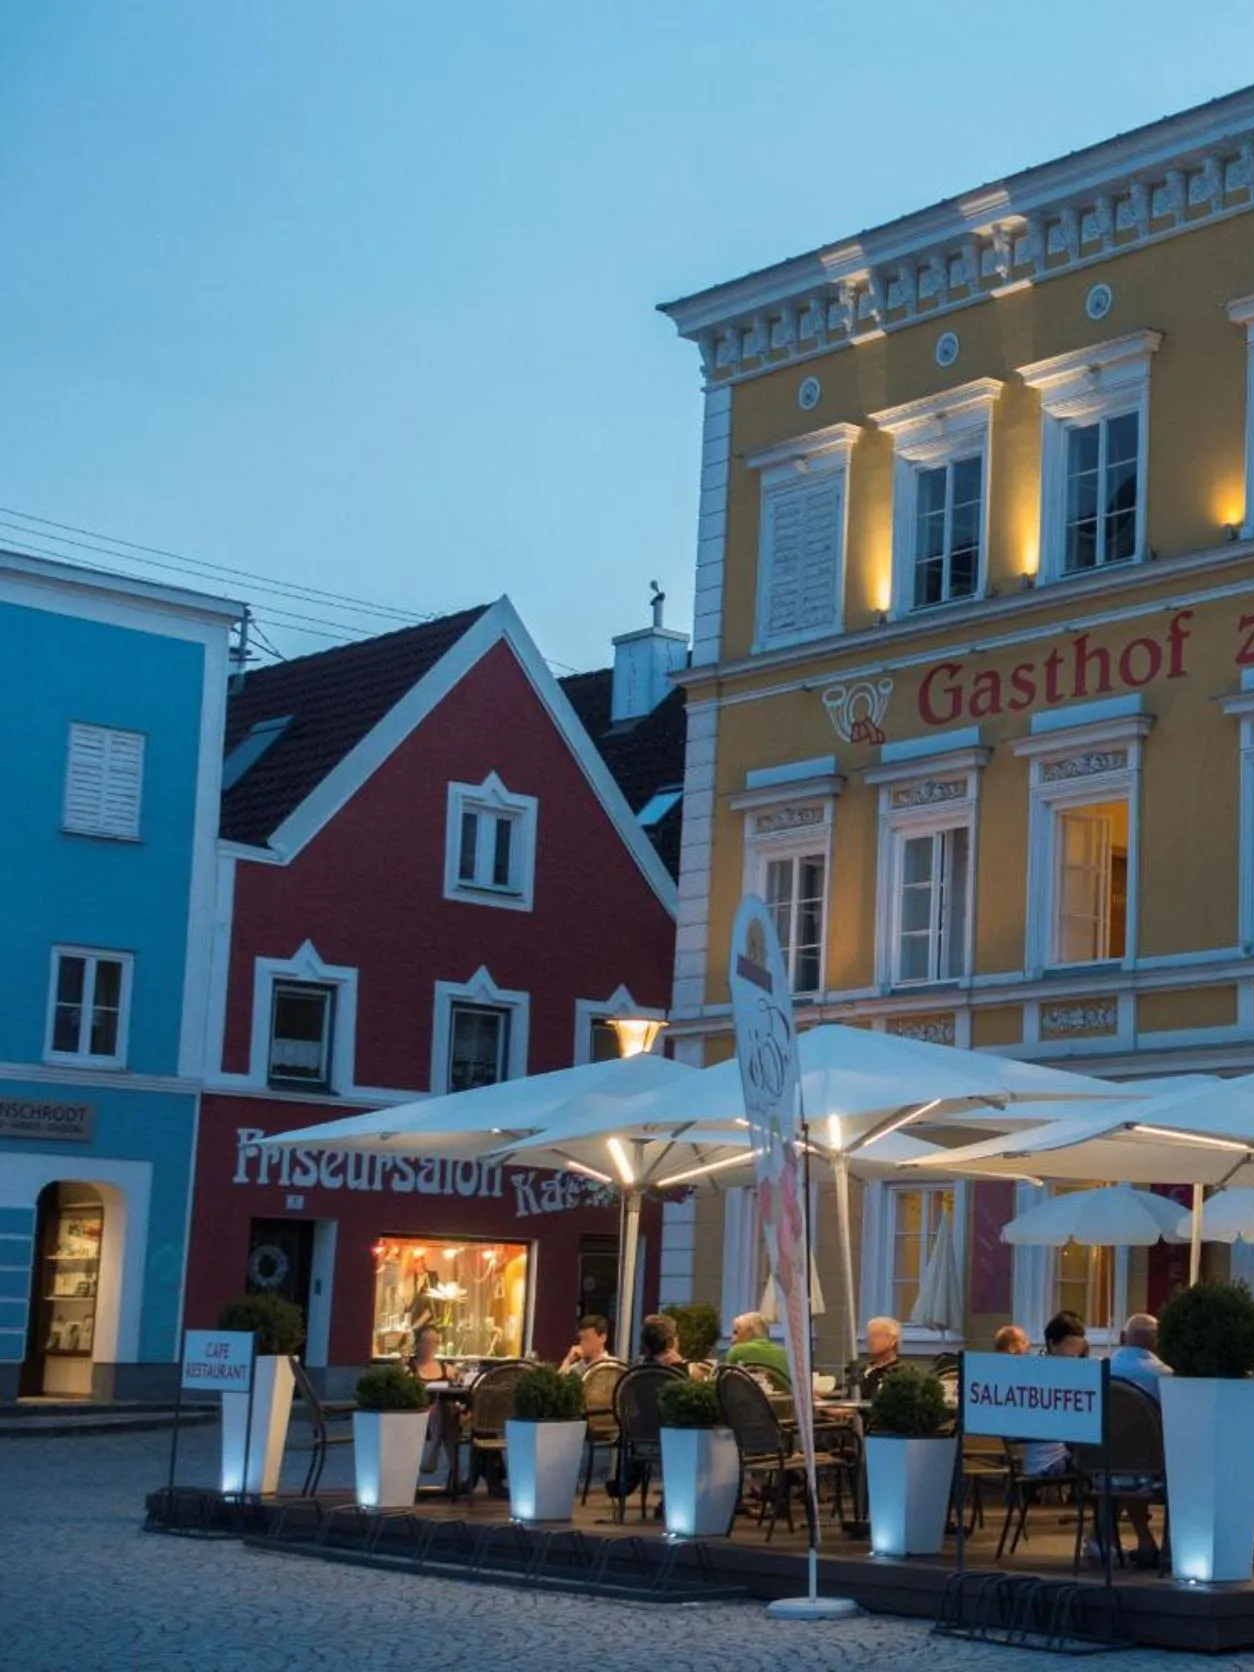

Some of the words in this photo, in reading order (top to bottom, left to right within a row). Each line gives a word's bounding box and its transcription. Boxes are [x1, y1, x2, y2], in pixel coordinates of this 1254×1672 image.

[918, 610, 1194, 726] Gasthof
[233, 1128, 503, 1197] Friseursalon
[970, 1382, 1096, 1412] SALATBUFFET
